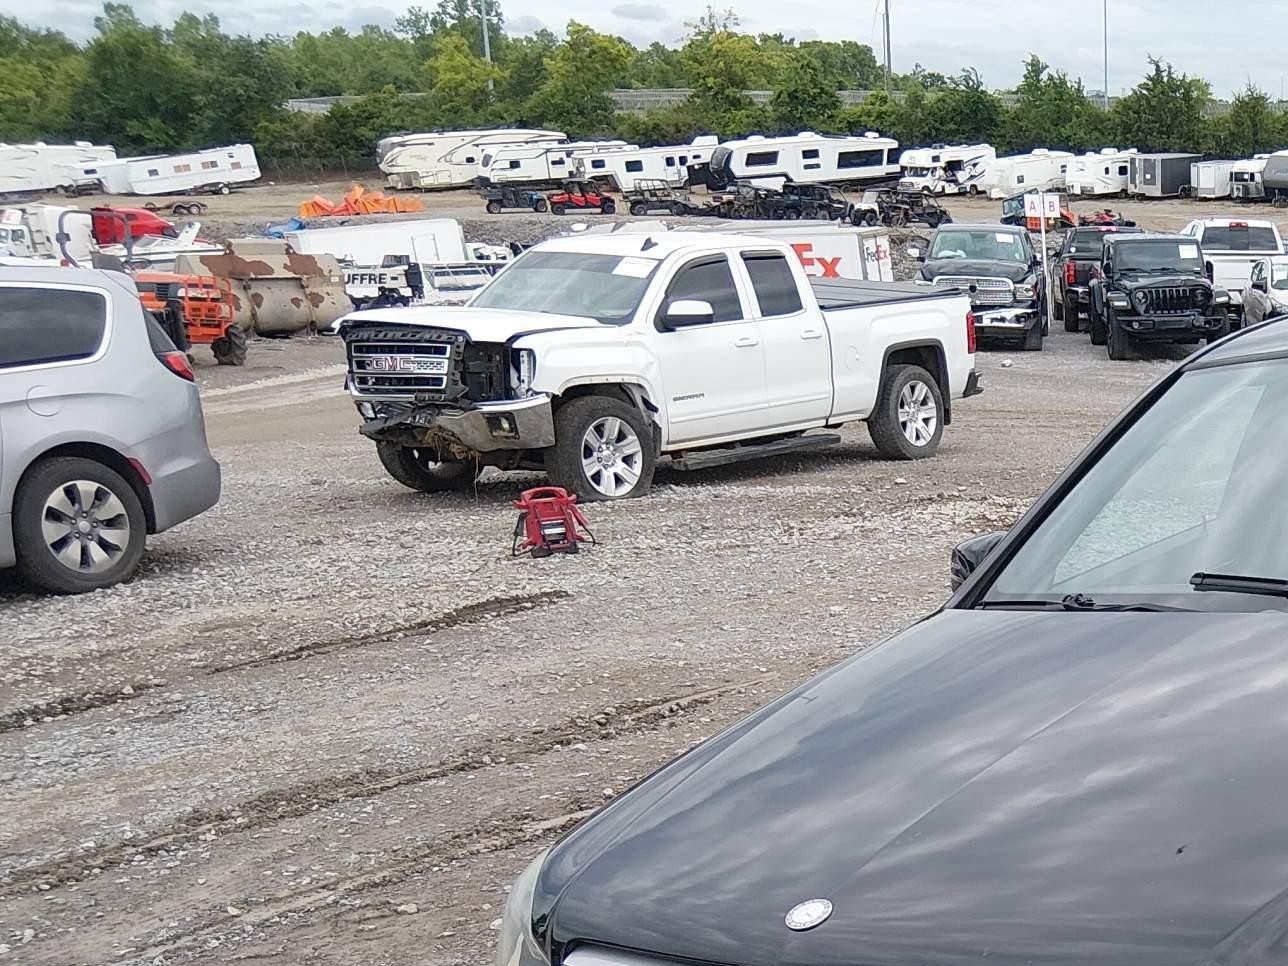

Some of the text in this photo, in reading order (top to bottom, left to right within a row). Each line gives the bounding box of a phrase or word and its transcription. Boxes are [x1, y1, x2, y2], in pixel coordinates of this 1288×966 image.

[1030, 199, 1038, 213] A
[1048, 200, 1056, 213] B
[865, 243, 888, 263] FedEx
[372, 355, 416, 371] GMC
